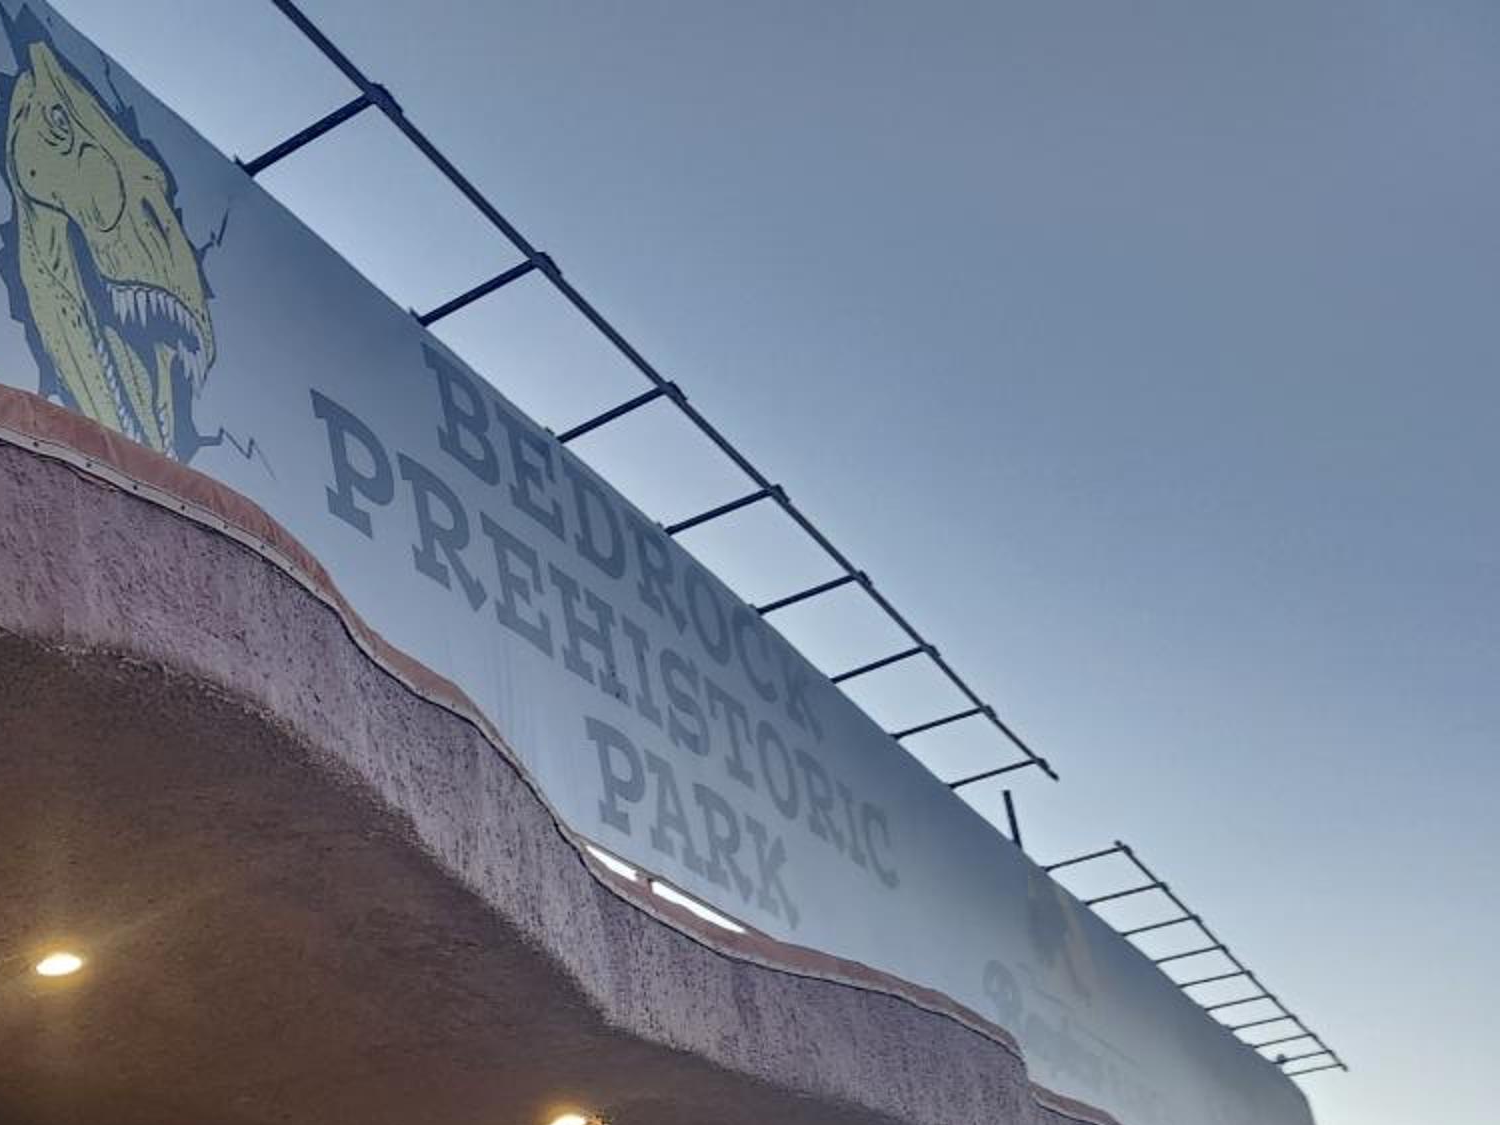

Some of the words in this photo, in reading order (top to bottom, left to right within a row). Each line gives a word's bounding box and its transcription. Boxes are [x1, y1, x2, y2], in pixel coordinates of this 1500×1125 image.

[309, 387, 899, 890] PREHISTORIC
[420, 341, 823, 745] BEDROCK
[585, 714, 799, 931] PARK
